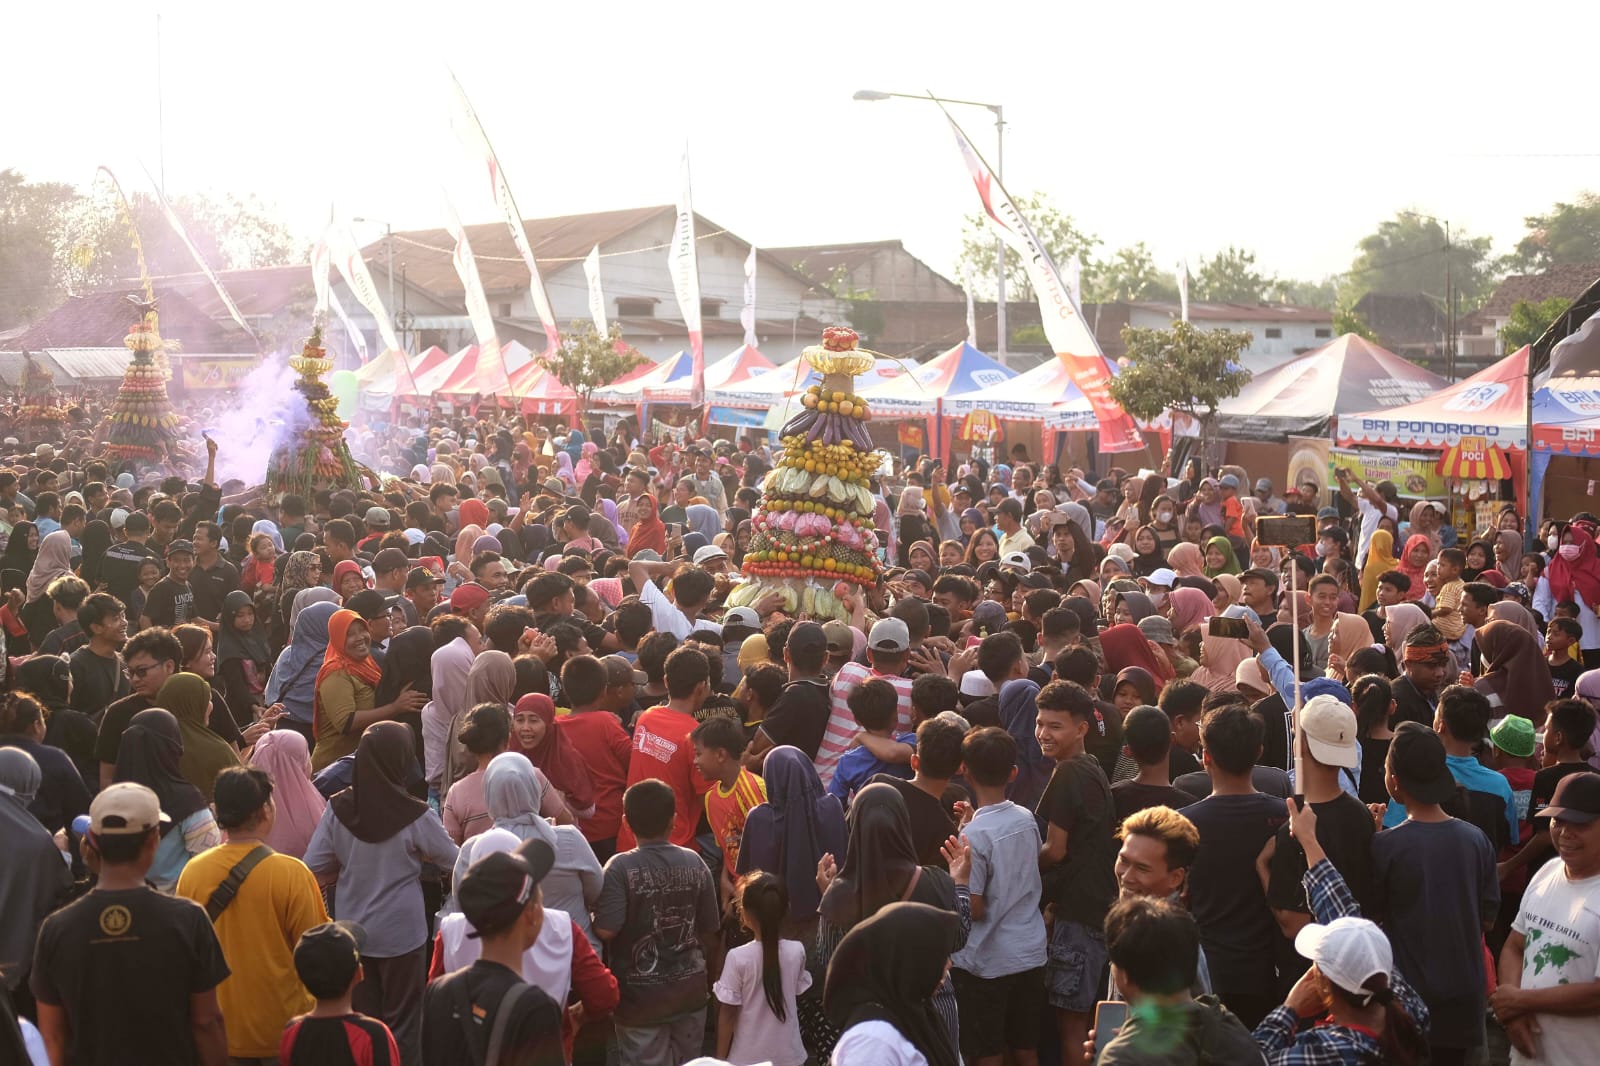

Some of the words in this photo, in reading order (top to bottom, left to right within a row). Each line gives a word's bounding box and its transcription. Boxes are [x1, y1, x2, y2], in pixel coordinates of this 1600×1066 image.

[1559, 391, 1595, 403] BRI
[956, 400, 972, 409] BRI
[976, 401, 1036, 412] PONOROGO
[1363, 419, 1390, 432] BRI
[1397, 421, 1500, 436] PONOROGO
[1562, 427, 1595, 442] BRI
[1461, 451, 1484, 461] POCI
[1539, 917, 1555, 930] THE
